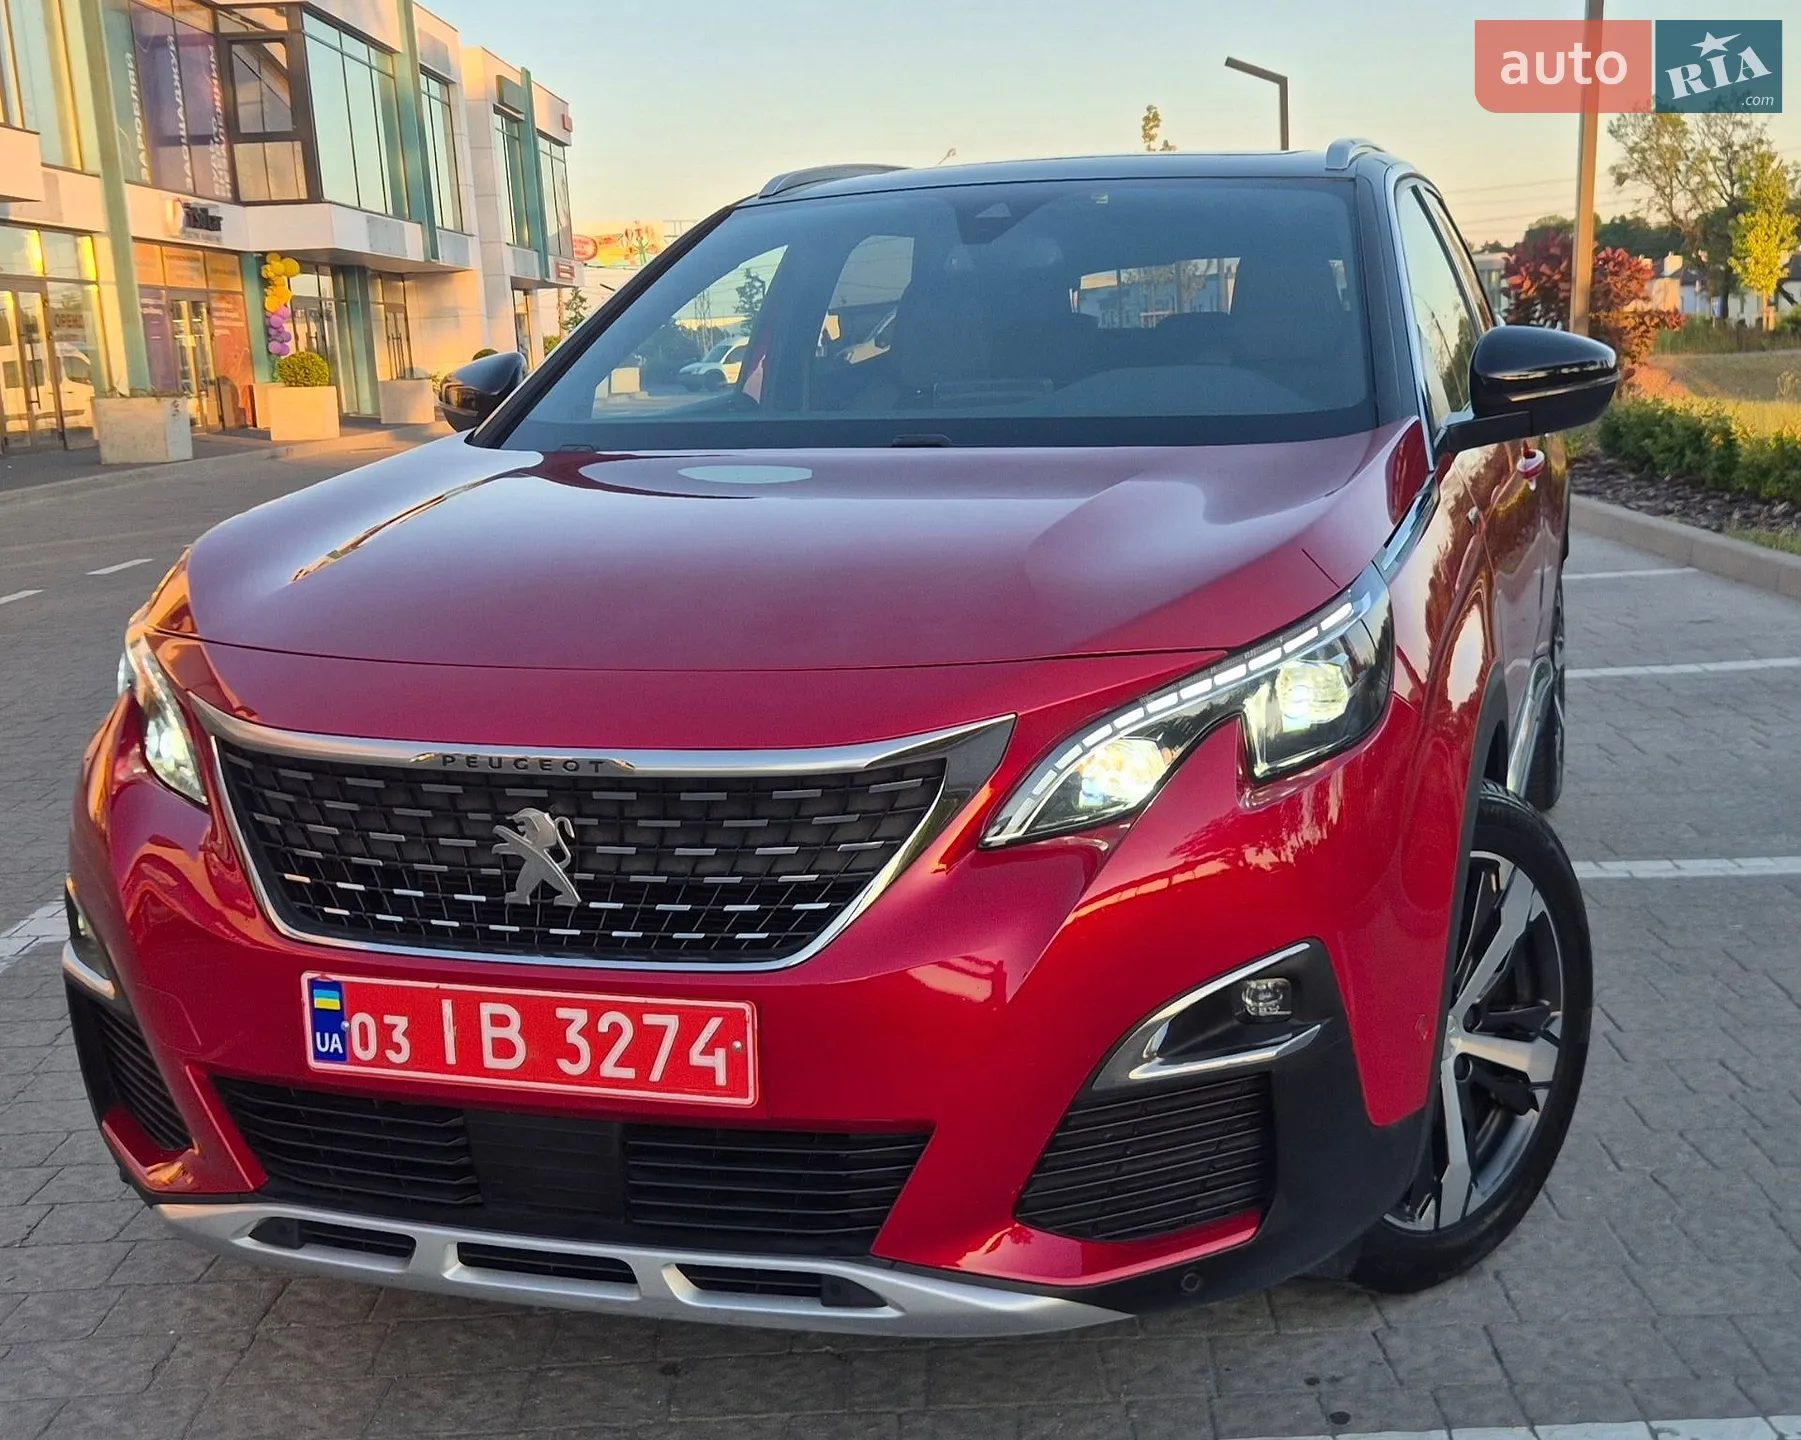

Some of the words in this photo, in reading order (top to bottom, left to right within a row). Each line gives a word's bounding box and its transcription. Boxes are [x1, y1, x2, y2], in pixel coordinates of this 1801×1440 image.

[441, 754, 605, 774] PEUGEOT
[315, 1031, 344, 1054] UA
[351, 1012, 411, 1064] 03
[555, 1007, 727, 1086] 3274
